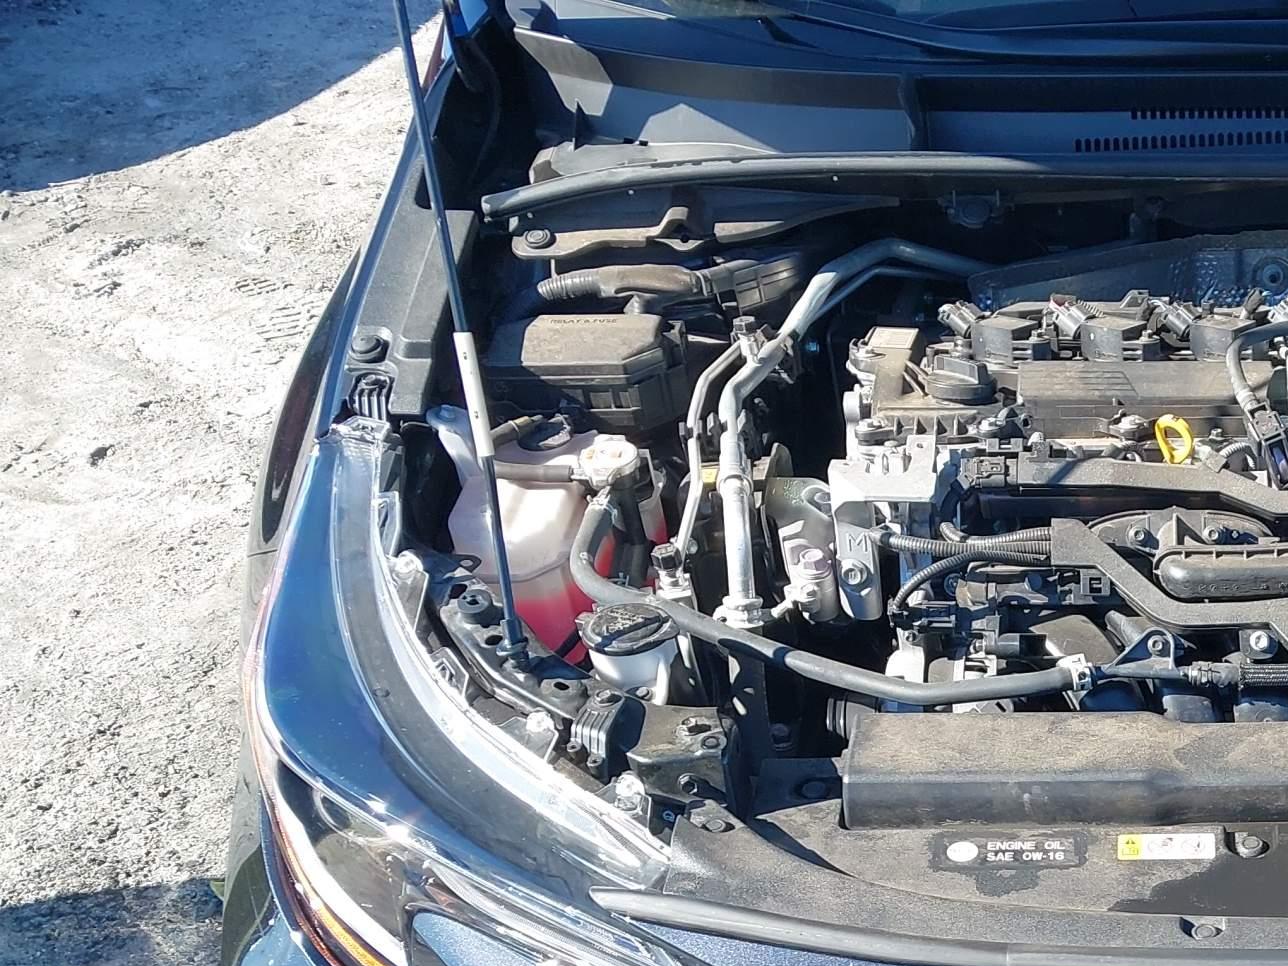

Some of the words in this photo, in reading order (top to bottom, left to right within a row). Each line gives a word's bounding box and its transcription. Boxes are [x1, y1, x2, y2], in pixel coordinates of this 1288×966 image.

[845, 532, 870, 553] M
[987, 840, 1036, 850] ENGINE
[1043, 840, 1067, 850] OIL
[986, 852, 1014, 861] SAE
[1022, 851, 1066, 861] 0W-16
